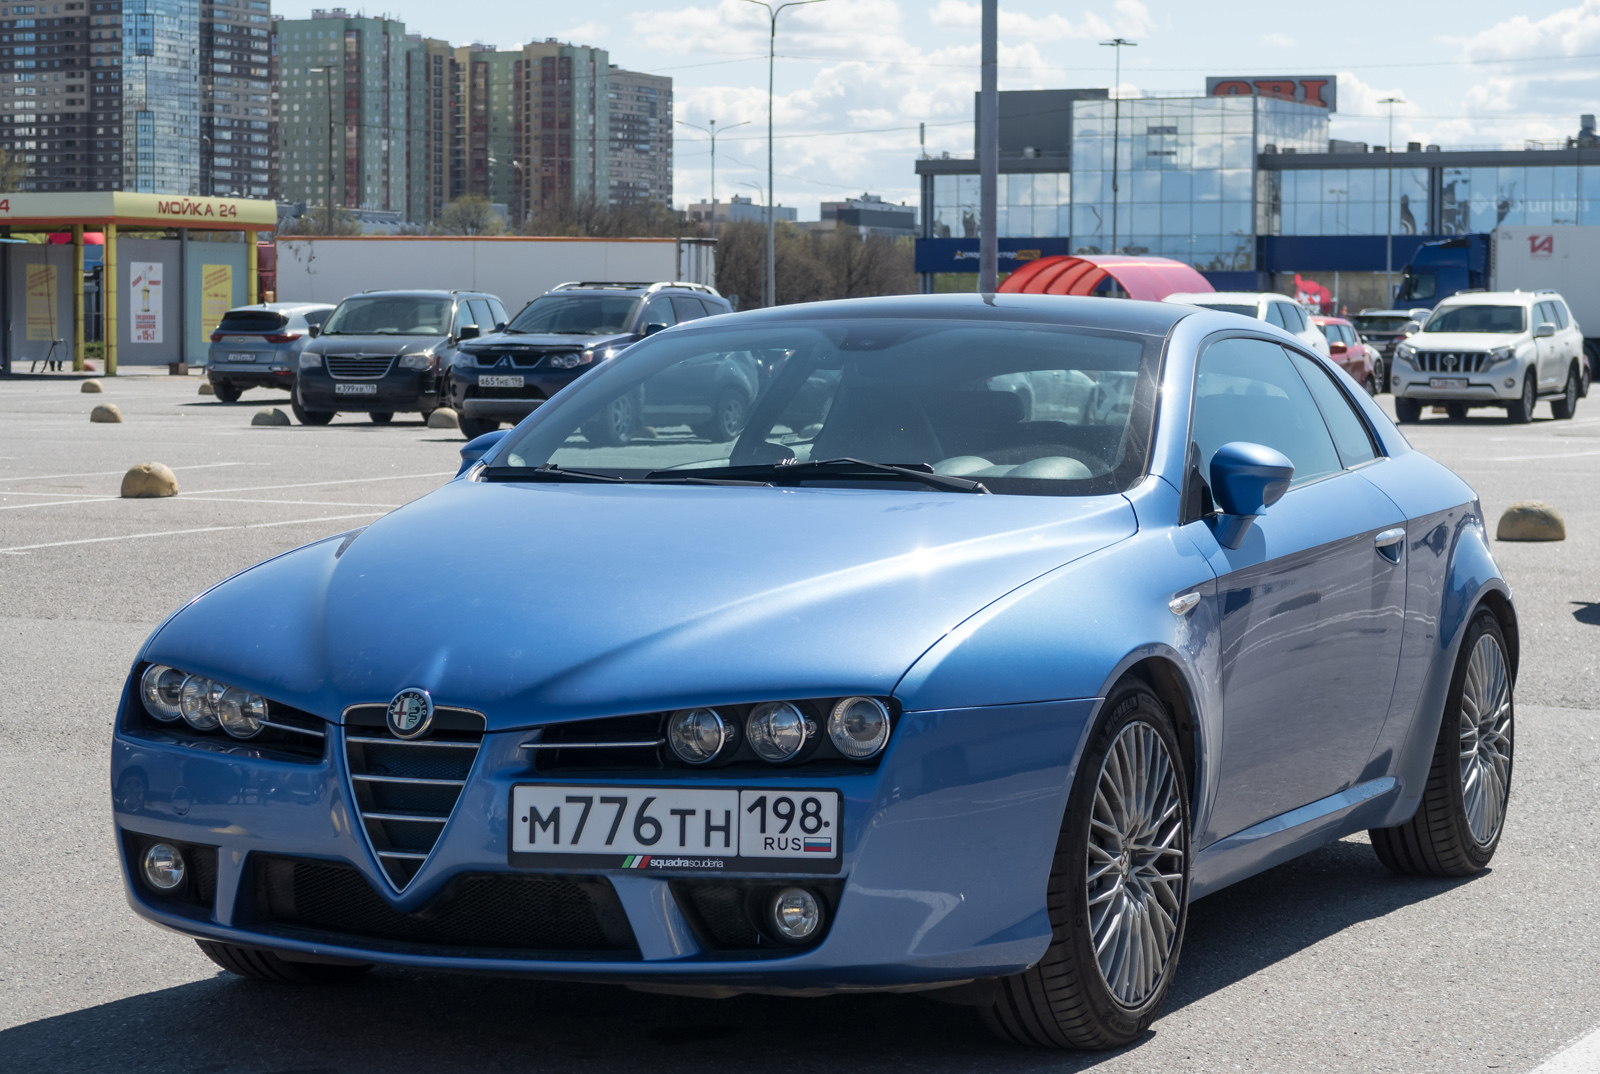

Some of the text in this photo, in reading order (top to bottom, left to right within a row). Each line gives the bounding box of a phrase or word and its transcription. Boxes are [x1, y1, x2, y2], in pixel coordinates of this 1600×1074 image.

[158, 198, 237, 218] МОЙКА 24
[389, 692, 427, 716] ALFA ROMEO
[1104, 695, 1139, 736] MICHELIN
[746, 795, 823, 835] 198
[764, 836, 802, 851] RUS
